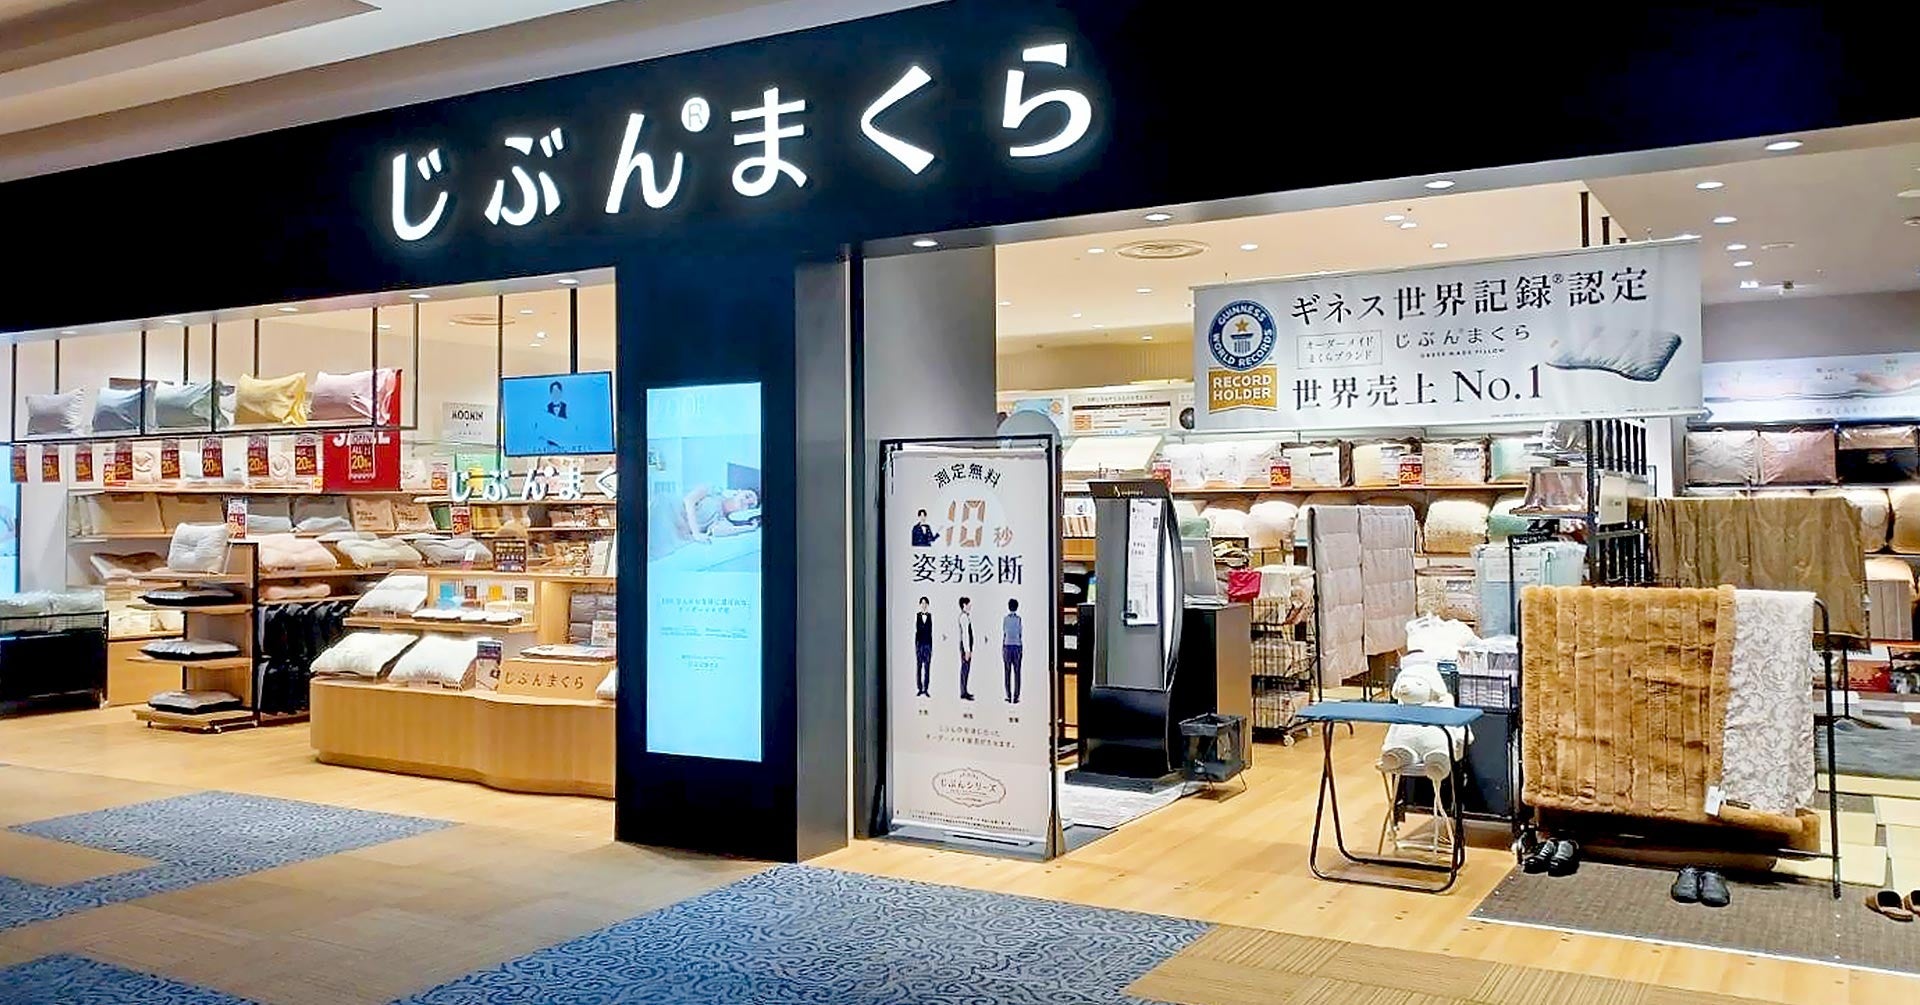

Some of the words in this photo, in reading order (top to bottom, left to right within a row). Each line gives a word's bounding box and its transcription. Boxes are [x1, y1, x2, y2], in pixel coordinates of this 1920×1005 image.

[1218, 302, 1266, 327] GUINNESS
[1212, 332, 1236, 366] WORLD
[1238, 328, 1273, 367] RECORDS
[1213, 374, 1272, 388] RECORD
[1213, 387, 1272, 401] HOLDER
[1292, 373, 1437, 410] 世界売上
[1452, 364, 1544, 403] No.1
[934, 463, 1002, 489] 測定無料
[912, 553, 1023, 585] 姿勢診断
